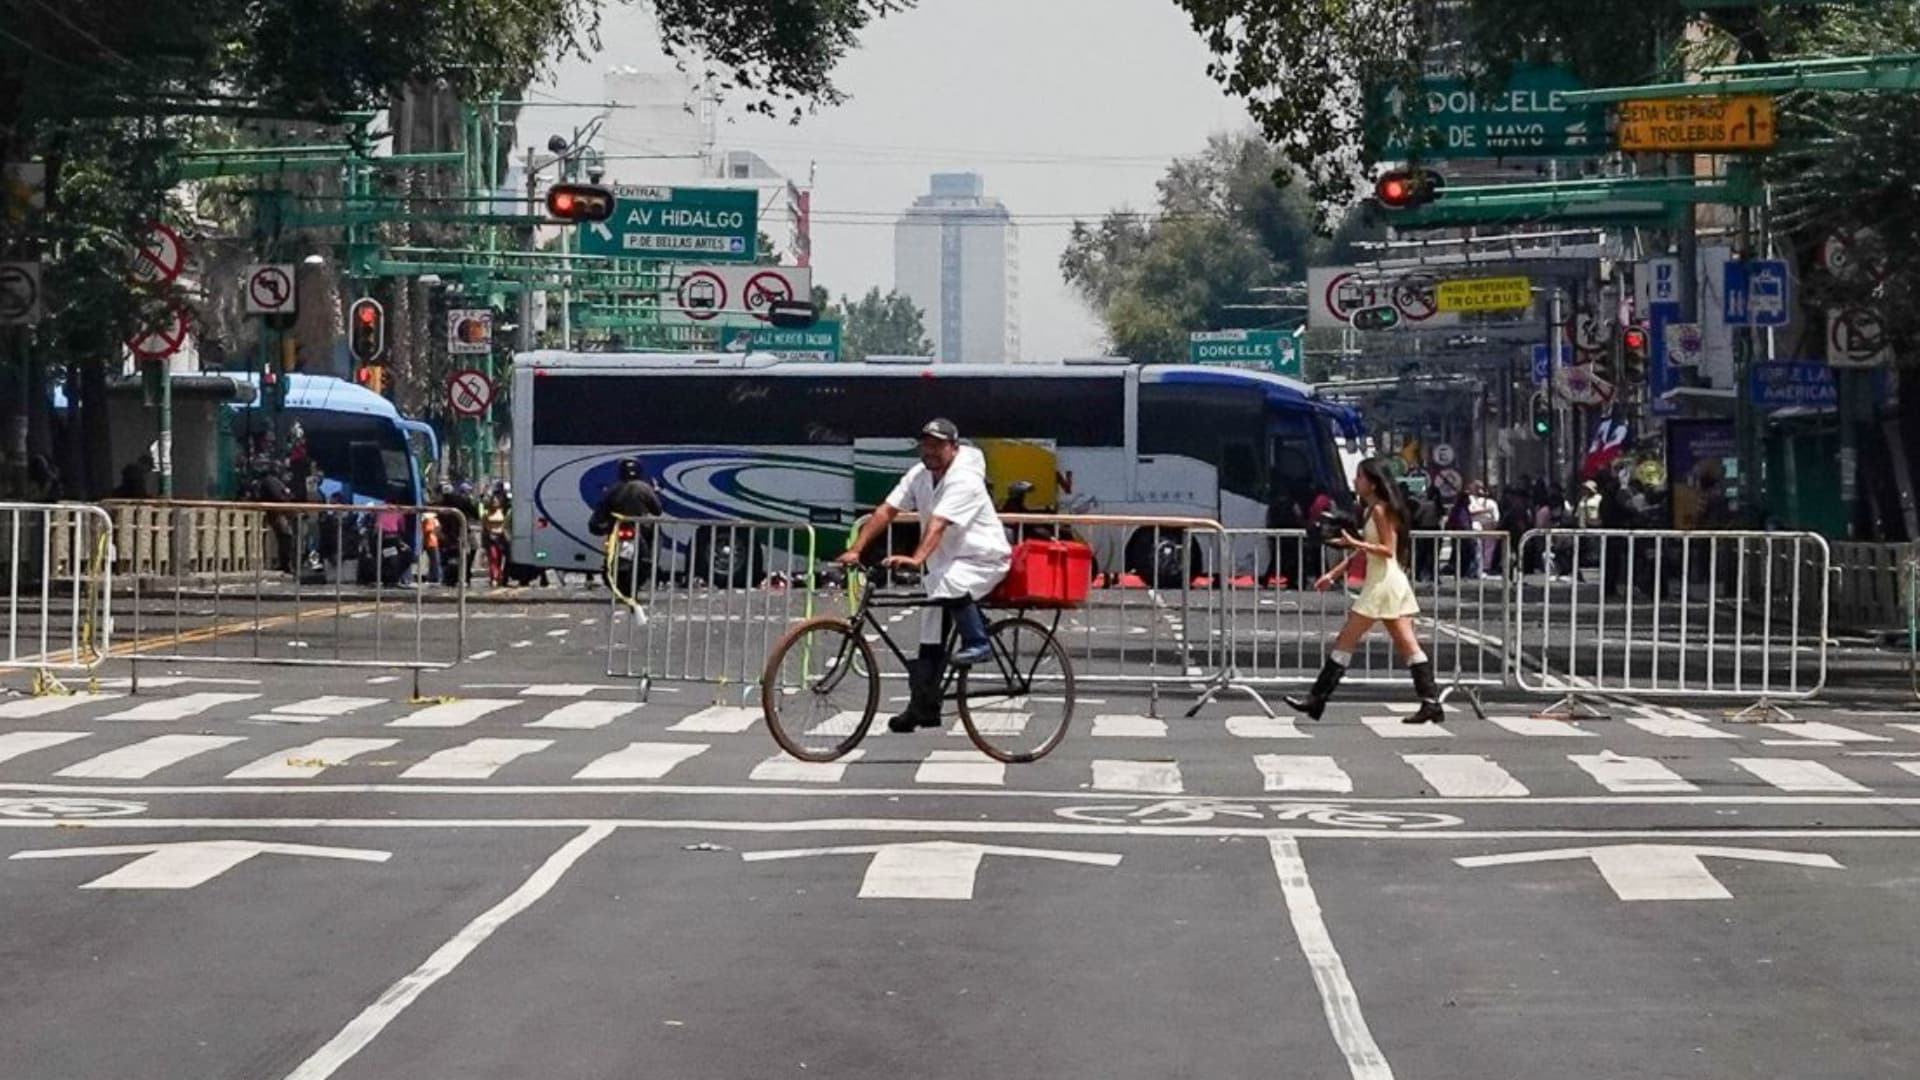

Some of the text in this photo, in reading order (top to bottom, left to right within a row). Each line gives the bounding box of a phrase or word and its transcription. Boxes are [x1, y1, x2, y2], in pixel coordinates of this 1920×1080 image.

[1449, 126, 1475, 147] DE
[1486, 124, 1544, 146] MAYO
[1623, 123, 1726, 144] AL TROLEBUS
[626, 208, 743, 228] AV HIDALGO
[655, 236, 692, 249] BELLAS
[695, 238, 725, 250] ARTES
[1446, 291, 1523, 307] TROLEBUS
[1200, 344, 1272, 358] DONCELES
